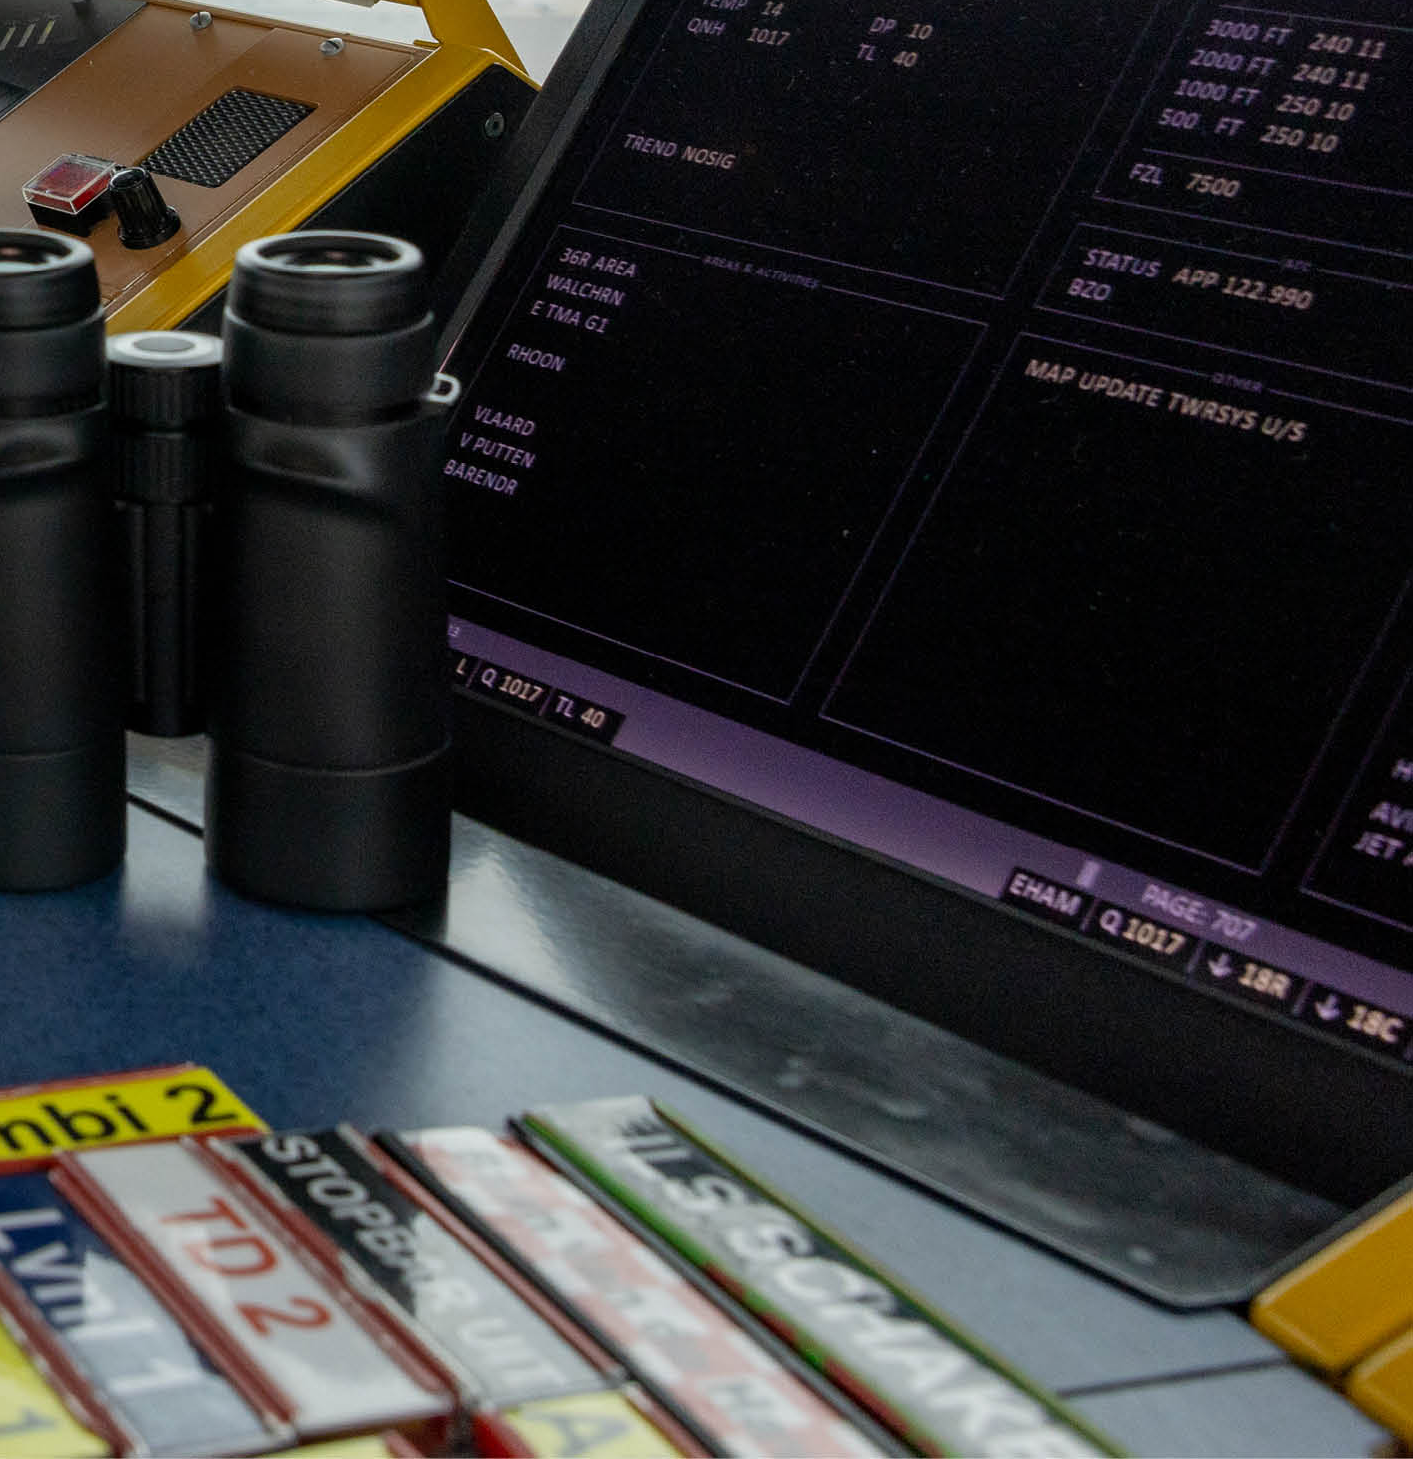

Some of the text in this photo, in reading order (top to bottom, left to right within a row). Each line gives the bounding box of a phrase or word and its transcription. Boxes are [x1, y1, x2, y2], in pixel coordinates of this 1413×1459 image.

[761, 0, 785, 18] 14
[866, 16, 934, 41] DP 10
[686, 17, 791, 47] QNH 1017
[1204, 19, 1387, 60] 3000 FT 240 11
[856, 42, 919, 69] TL 40
[1189, 48, 1372, 92] 2000 FT 240 11
[1173, 78, 1356, 123] 1000 FT 250 10
[1157, 107, 1340, 154] 500 FT 250 10
[622, 132, 737, 170] TREND NOSIG
[1127, 162, 1242, 199] FZL 7500
[558, 248, 638, 278] 36R AREA
[1081, 247, 1314, 311] STATUS APP 122.990
[545, 273, 625, 307] WALCHRN
[529, 300, 544, 319] E
[546, 303, 582, 328] TMA
[506, 343, 567, 373] RHOON
[1023, 358, 1311, 444] MAP UPDATE TWRSYS U/S
[474, 404, 535, 438] VLAARD
[460, 431, 537, 470] V PUTTEN
[442, 458, 519, 497] BARENDR
[480, 668, 608, 730] Q 1017 TL 40
[1009, 873, 1405, 1044] EHAM Q 1017 18R 18C
[165, 1082, 241, 1125] 2
[160, 1196, 332, 1339] TD 2
